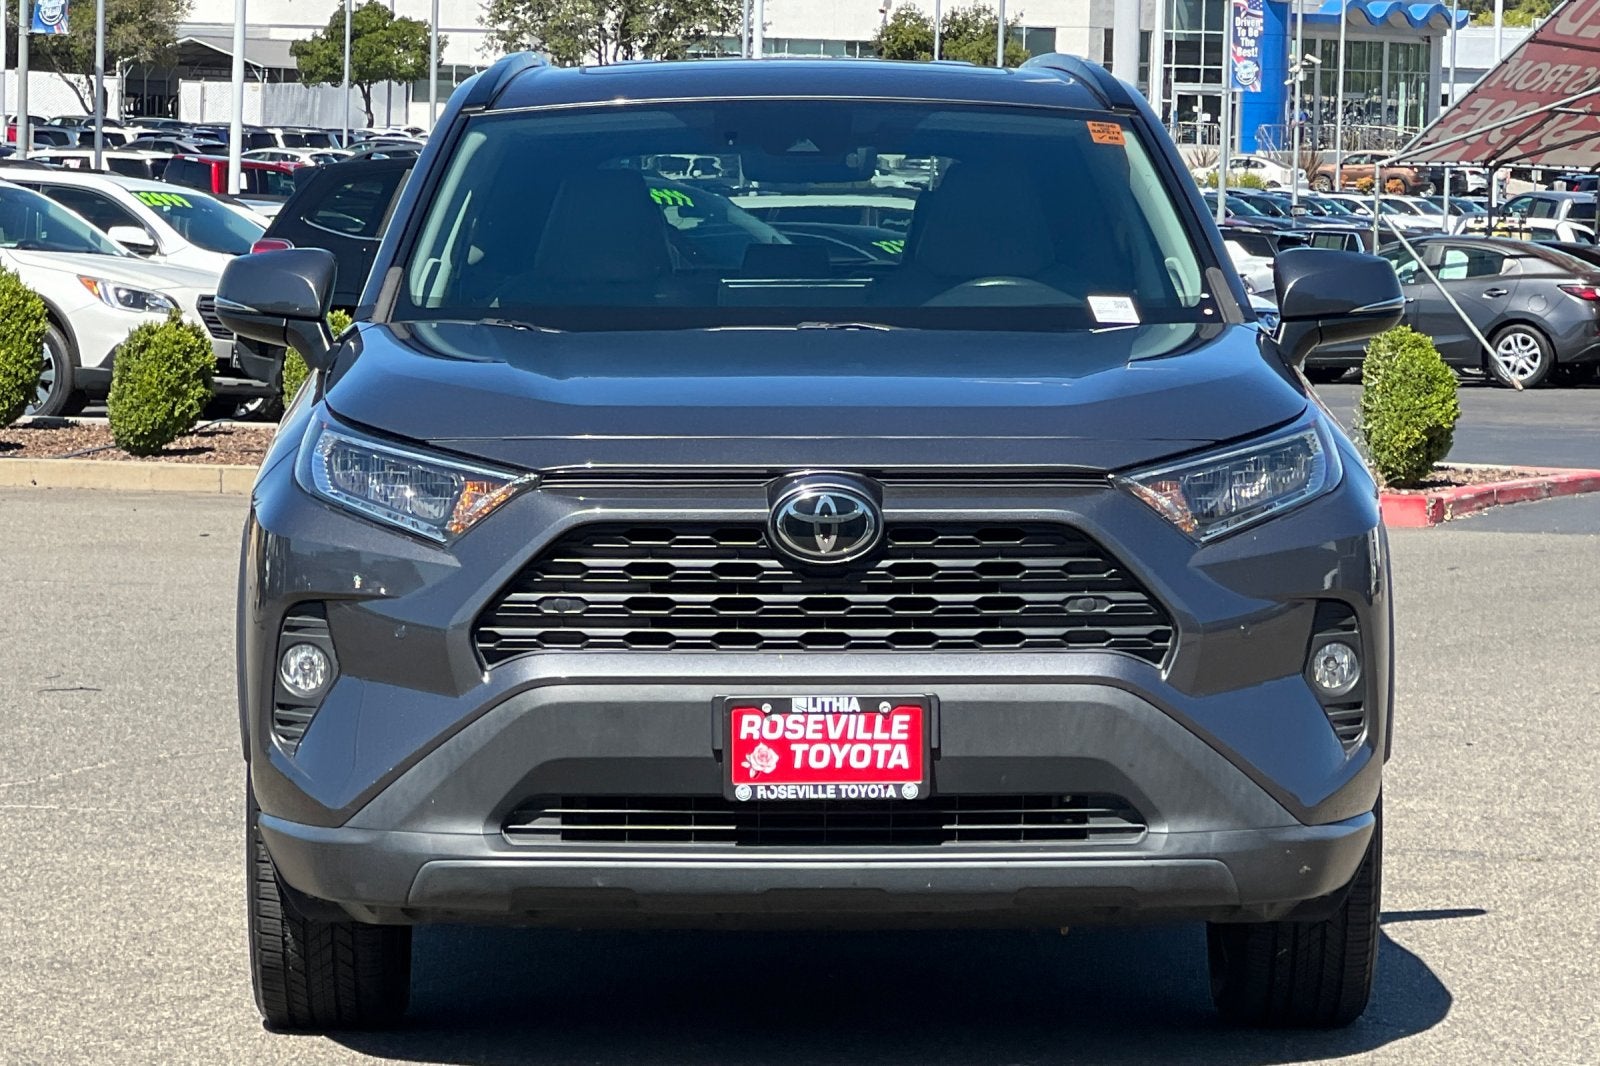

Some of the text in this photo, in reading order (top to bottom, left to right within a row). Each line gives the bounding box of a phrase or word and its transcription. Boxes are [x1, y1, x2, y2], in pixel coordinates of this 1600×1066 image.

[1236, 27, 1247, 37] To
[1240, 37, 1256, 47] The
[806, 697, 861, 713] LITHIA
[739, 714, 911, 740] ROSEVILLE
[790, 743, 910, 770] TOYOTA
[757, 785, 897, 799] ROSEVILLE TOYOTA
